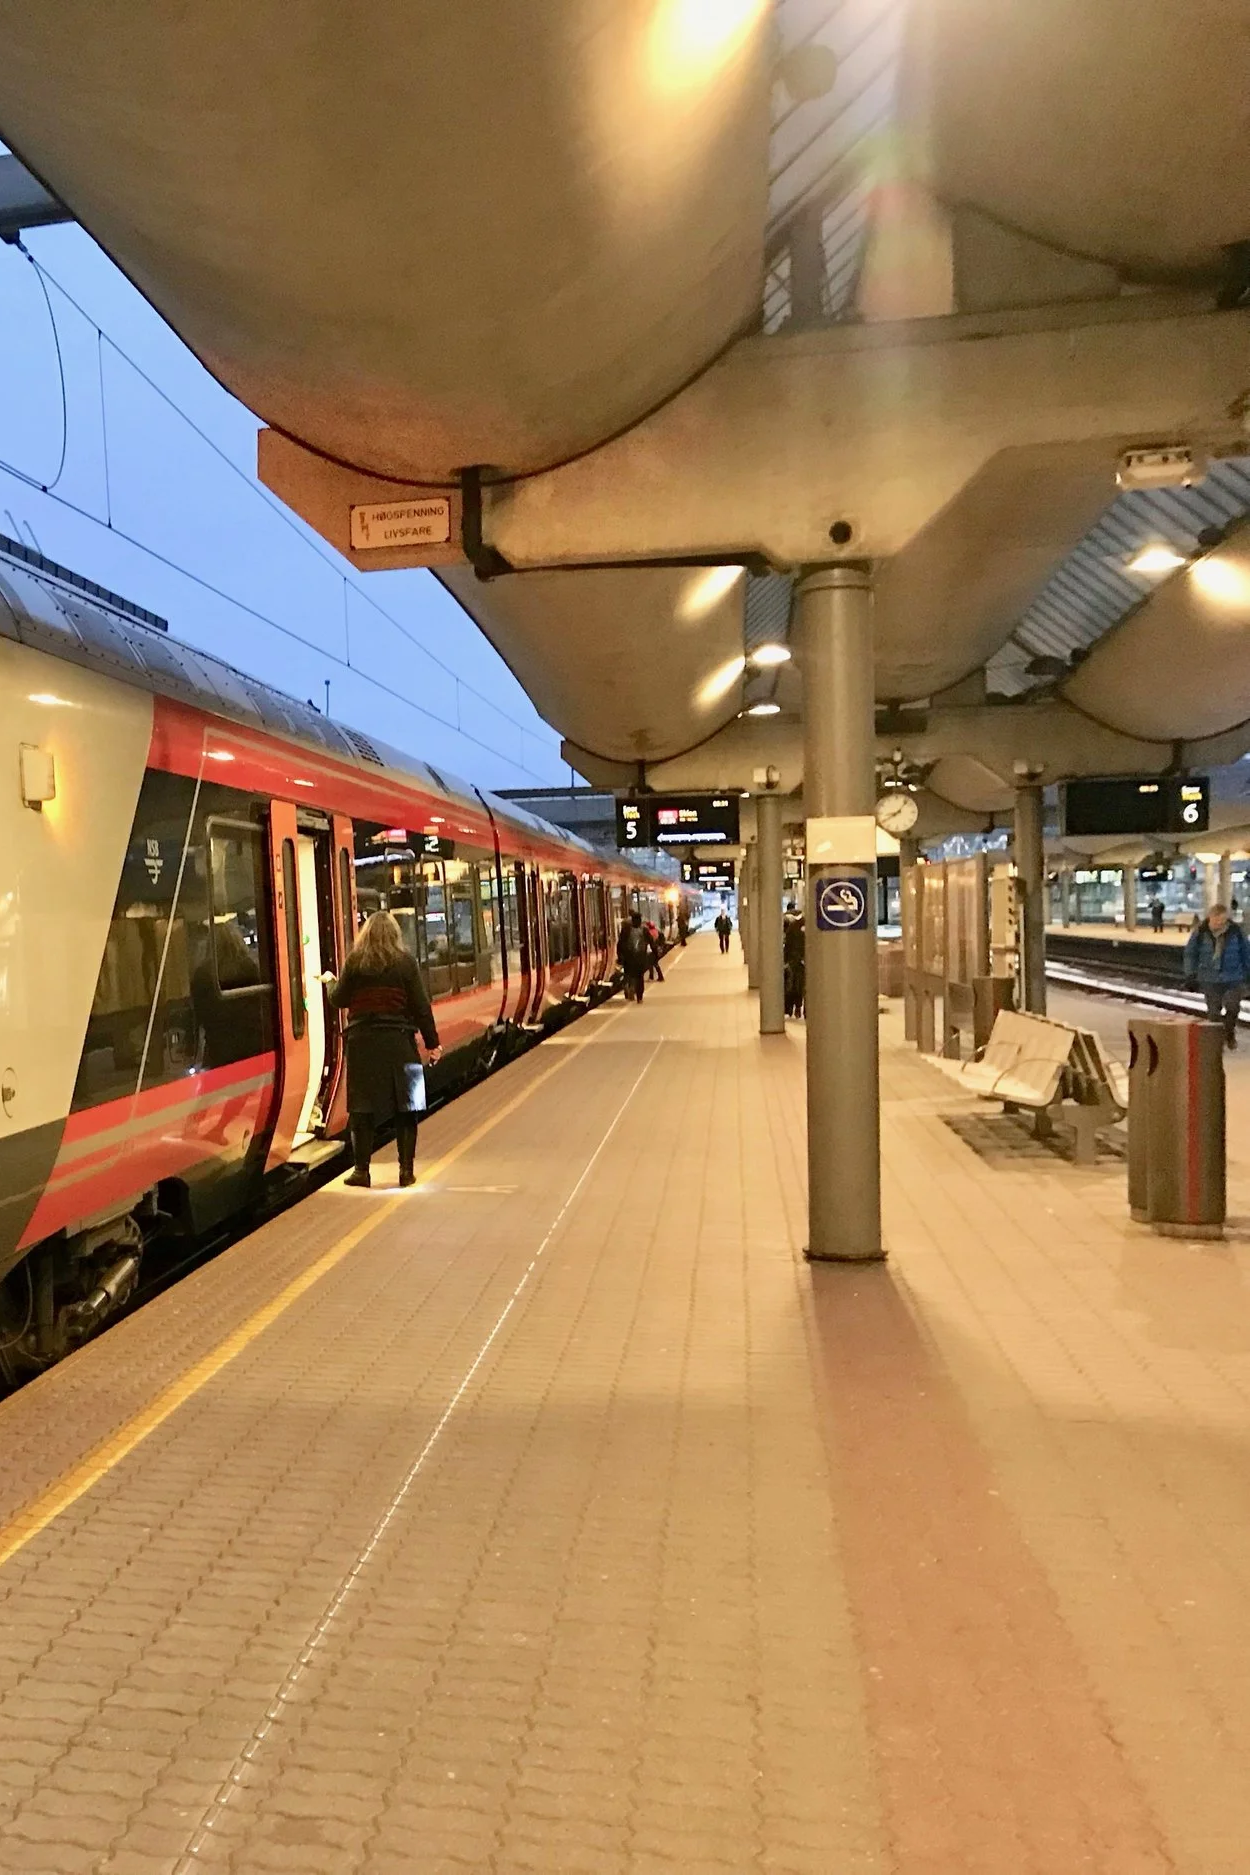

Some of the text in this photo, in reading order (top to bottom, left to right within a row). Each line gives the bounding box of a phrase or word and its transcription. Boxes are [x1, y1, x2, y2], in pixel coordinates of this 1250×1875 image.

[372, 506, 445, 521] HØGSPENNING
[384, 525, 433, 540] LIVSFARE
[1183, 803, 1199, 824] 6
[626, 821, 638, 840] 5
[147, 838, 160, 857] NSB
